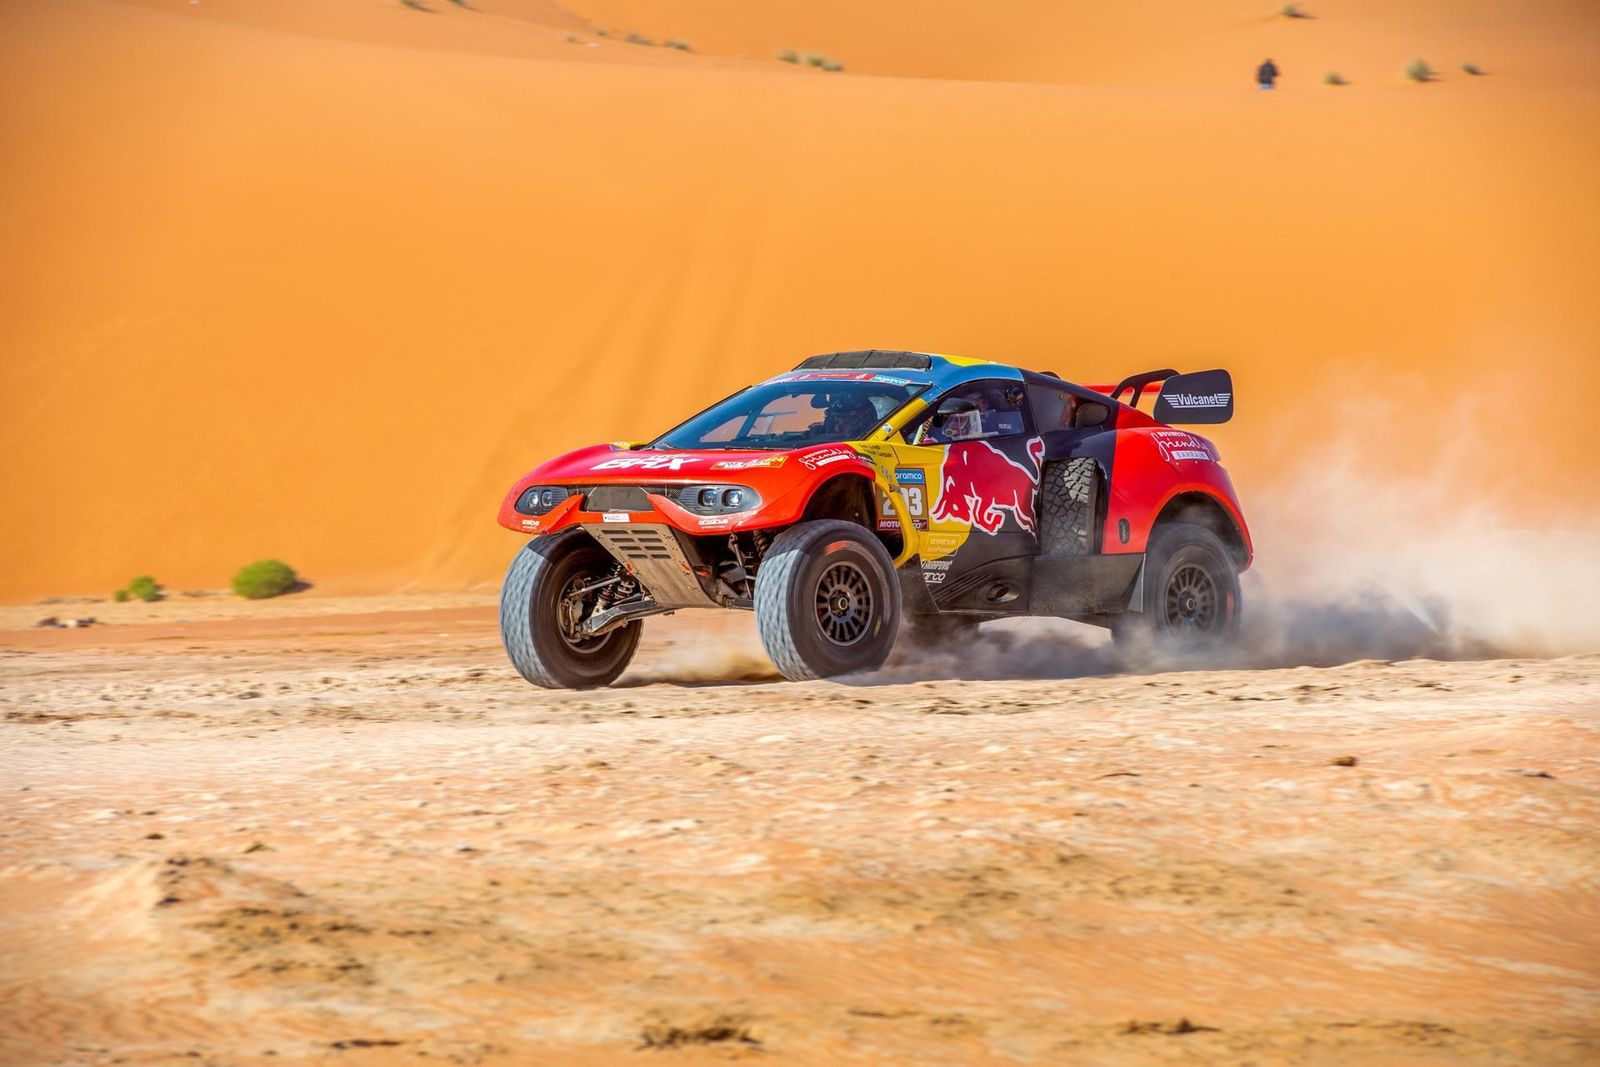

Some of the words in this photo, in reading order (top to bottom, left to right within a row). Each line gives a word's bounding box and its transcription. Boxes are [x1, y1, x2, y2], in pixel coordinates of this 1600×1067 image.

[1177, 393, 1220, 405] Vulcanet
[896, 472, 923, 480] aramco
[879, 521, 901, 529] MOTU
[923, 572, 946, 583] arco
